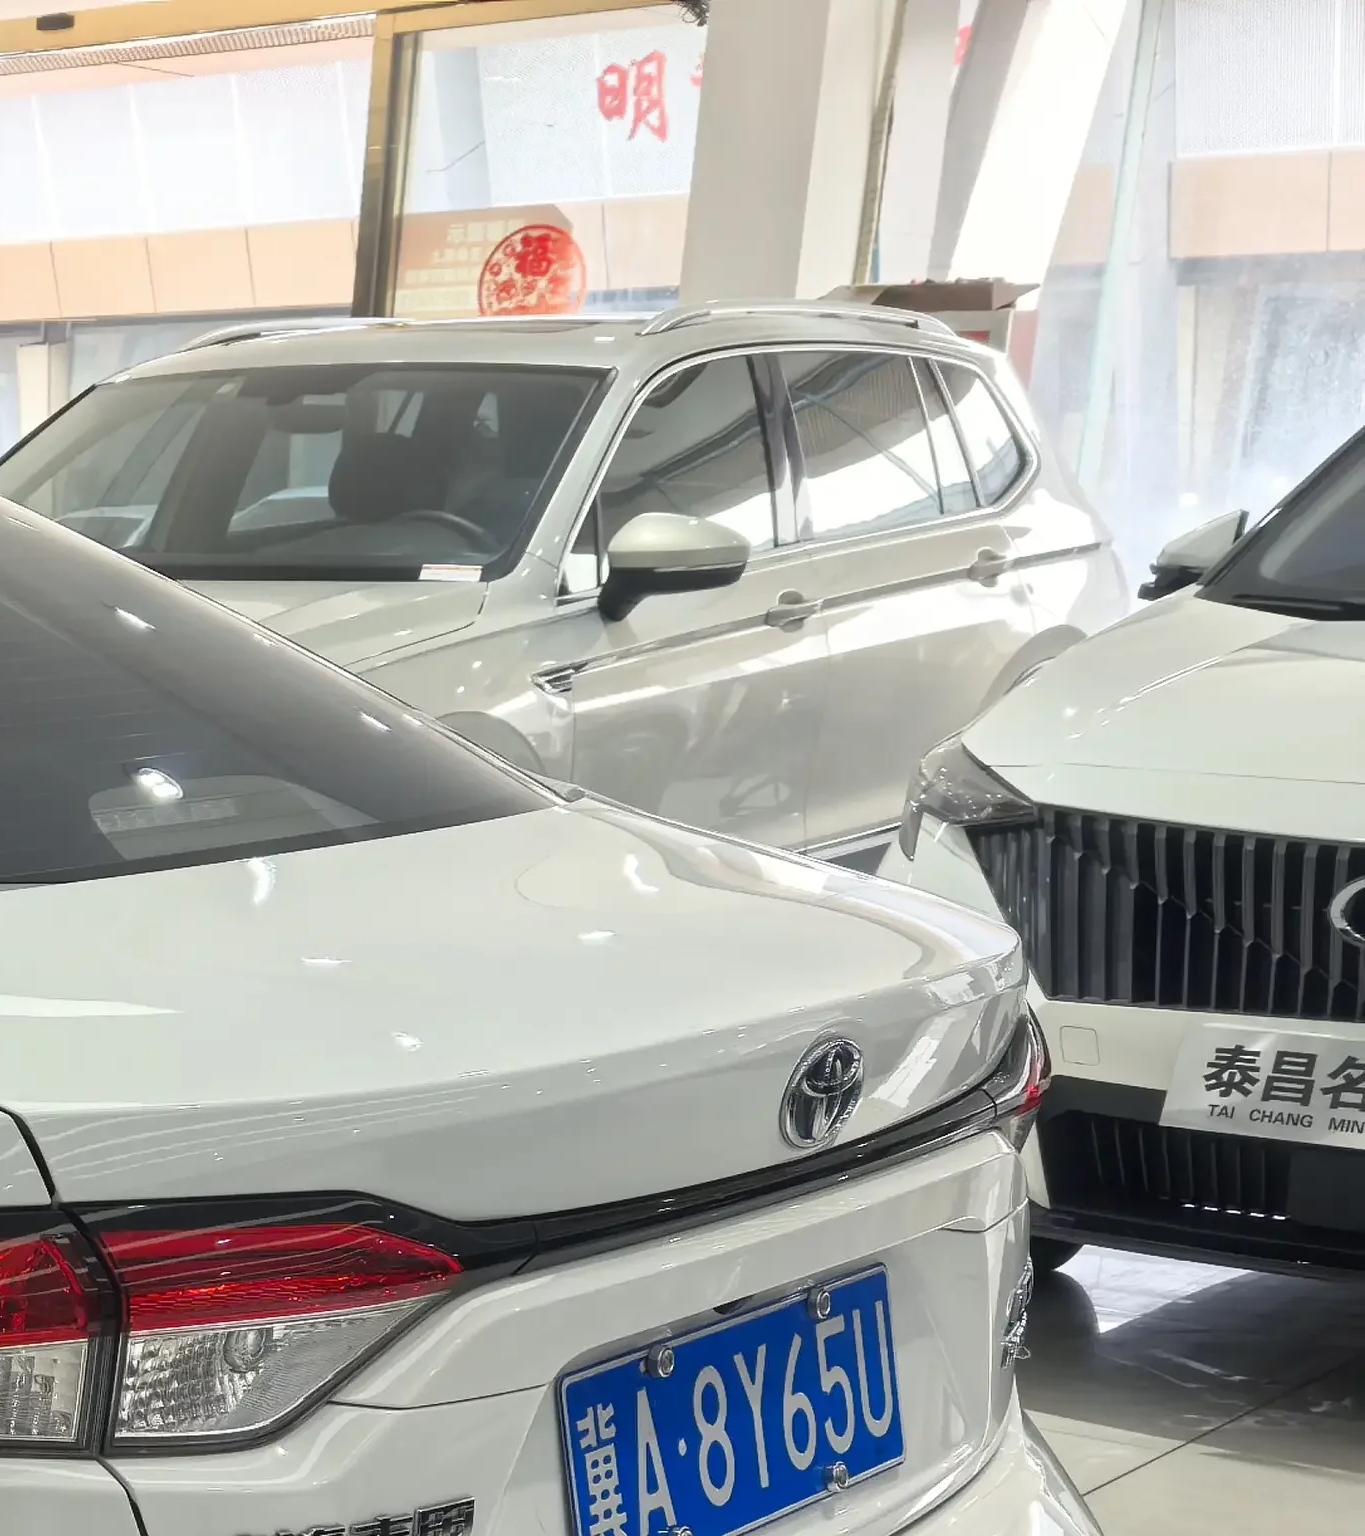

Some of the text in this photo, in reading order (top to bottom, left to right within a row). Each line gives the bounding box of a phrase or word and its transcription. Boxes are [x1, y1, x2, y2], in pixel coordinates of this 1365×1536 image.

[1203, 1045, 1365, 1112] 泰昌名
[1208, 1104, 1235, 1119] TAI
[1249, 1109, 1313, 1128] CHANG
